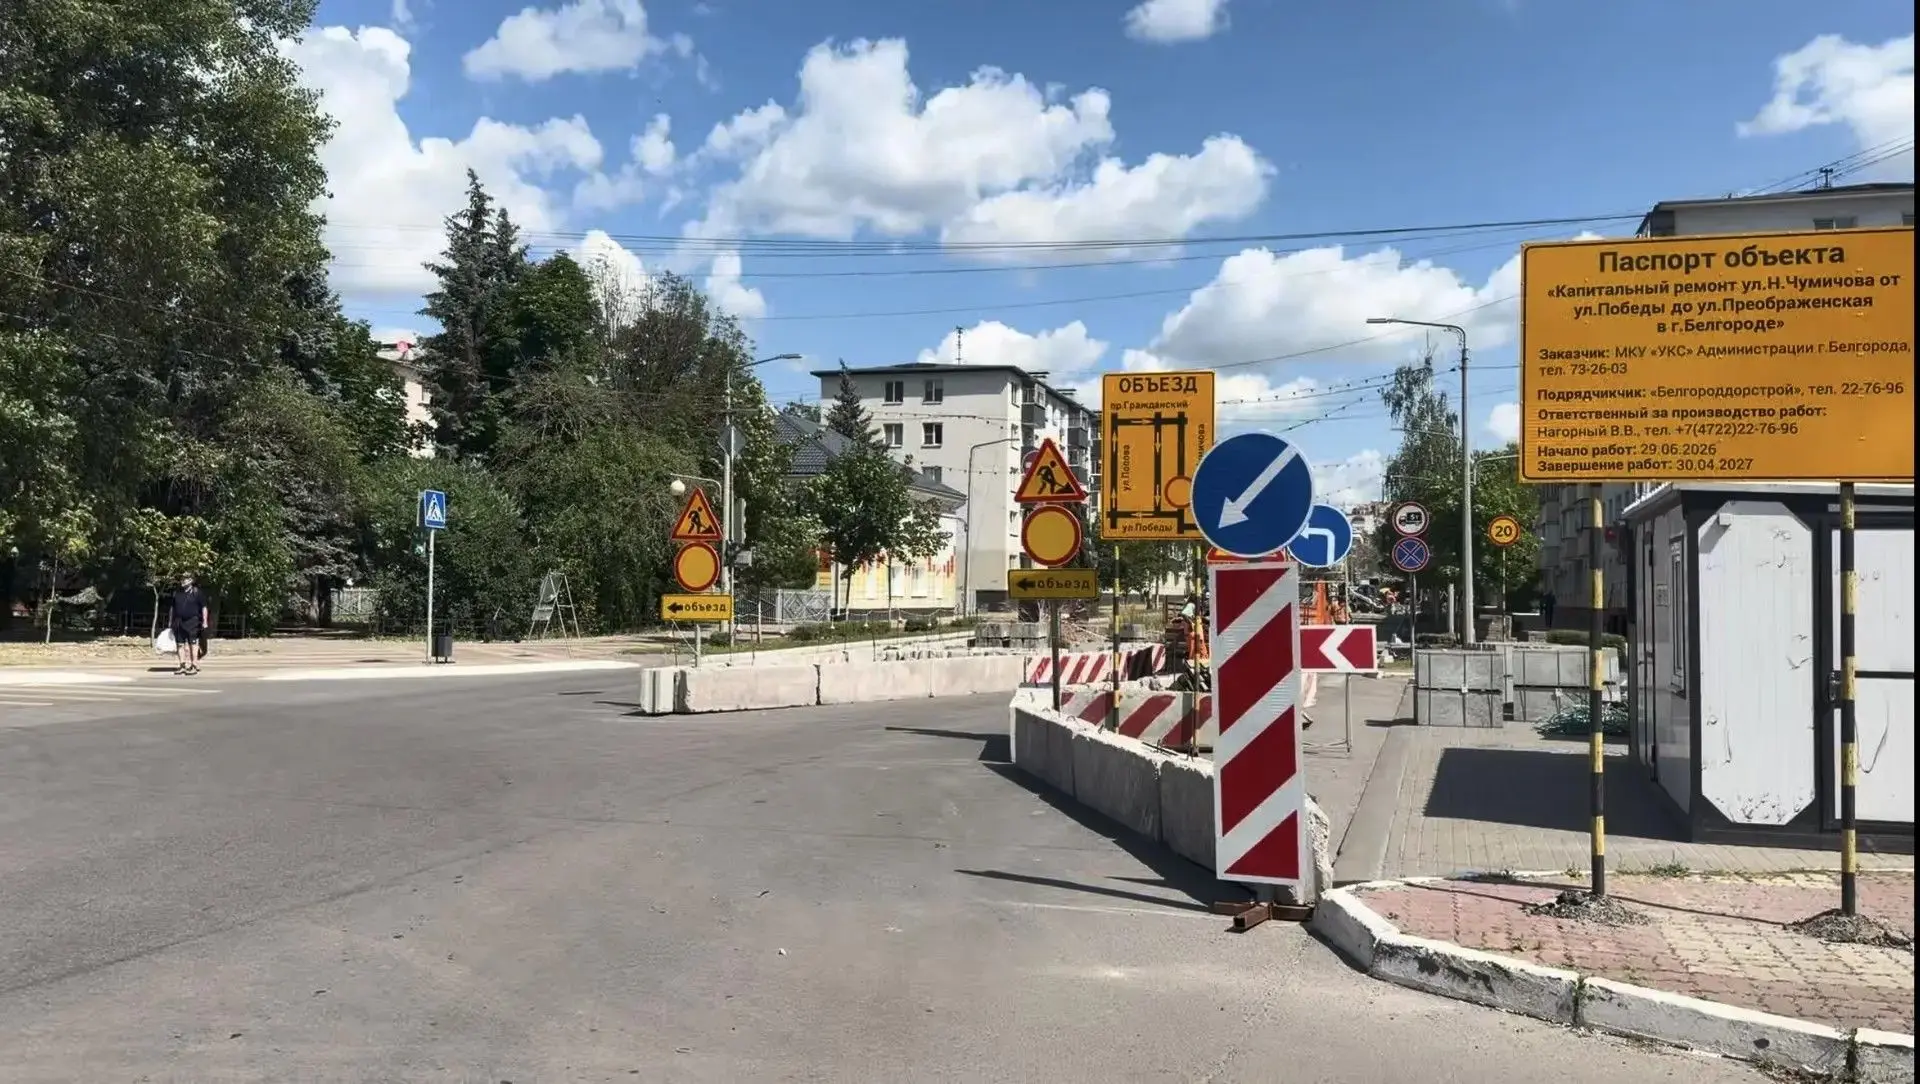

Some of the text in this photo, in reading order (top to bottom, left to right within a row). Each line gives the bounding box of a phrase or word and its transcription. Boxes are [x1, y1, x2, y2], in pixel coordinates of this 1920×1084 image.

[1600, 244, 1845, 274] Паспорт объекта
[1547, 275, 1901, 298] «Капитальный ремонт ул.Н.Чумичова от
[1574, 296, 1873, 319] ул.Победы до ул.Преображенская
[1657, 318, 1785, 333] в г.Белгороде»
[1539, 348, 1610, 360] Заказчик:
[1615, 346, 1647, 358] МКУ
[1650, 345, 1693, 357] «УКС»
[1696, 343, 1814, 359] Администрации
[1539, 363, 1628, 376] тел. 73-26-03
[1119, 376, 1198, 394] ОБЪЕЗД
[1537, 382, 1904, 401] Подрядчикчик: «Белгороддорстрой», тел. 22-76-96
[1538, 405, 1827, 420] Ответственный за производство работ:
[1537, 423, 1798, 438] Нагорный В.В., тел. +7(4722)22-76-96
[1537, 443, 1717, 458] Начало работ: 29.06.2026
[1537, 458, 1754, 473] Завершение работ: 30.04.2027
[1495, 525, 1513, 538] 20
[1037, 577, 1090, 590] объезд
[685, 601, 727, 612] объезд
